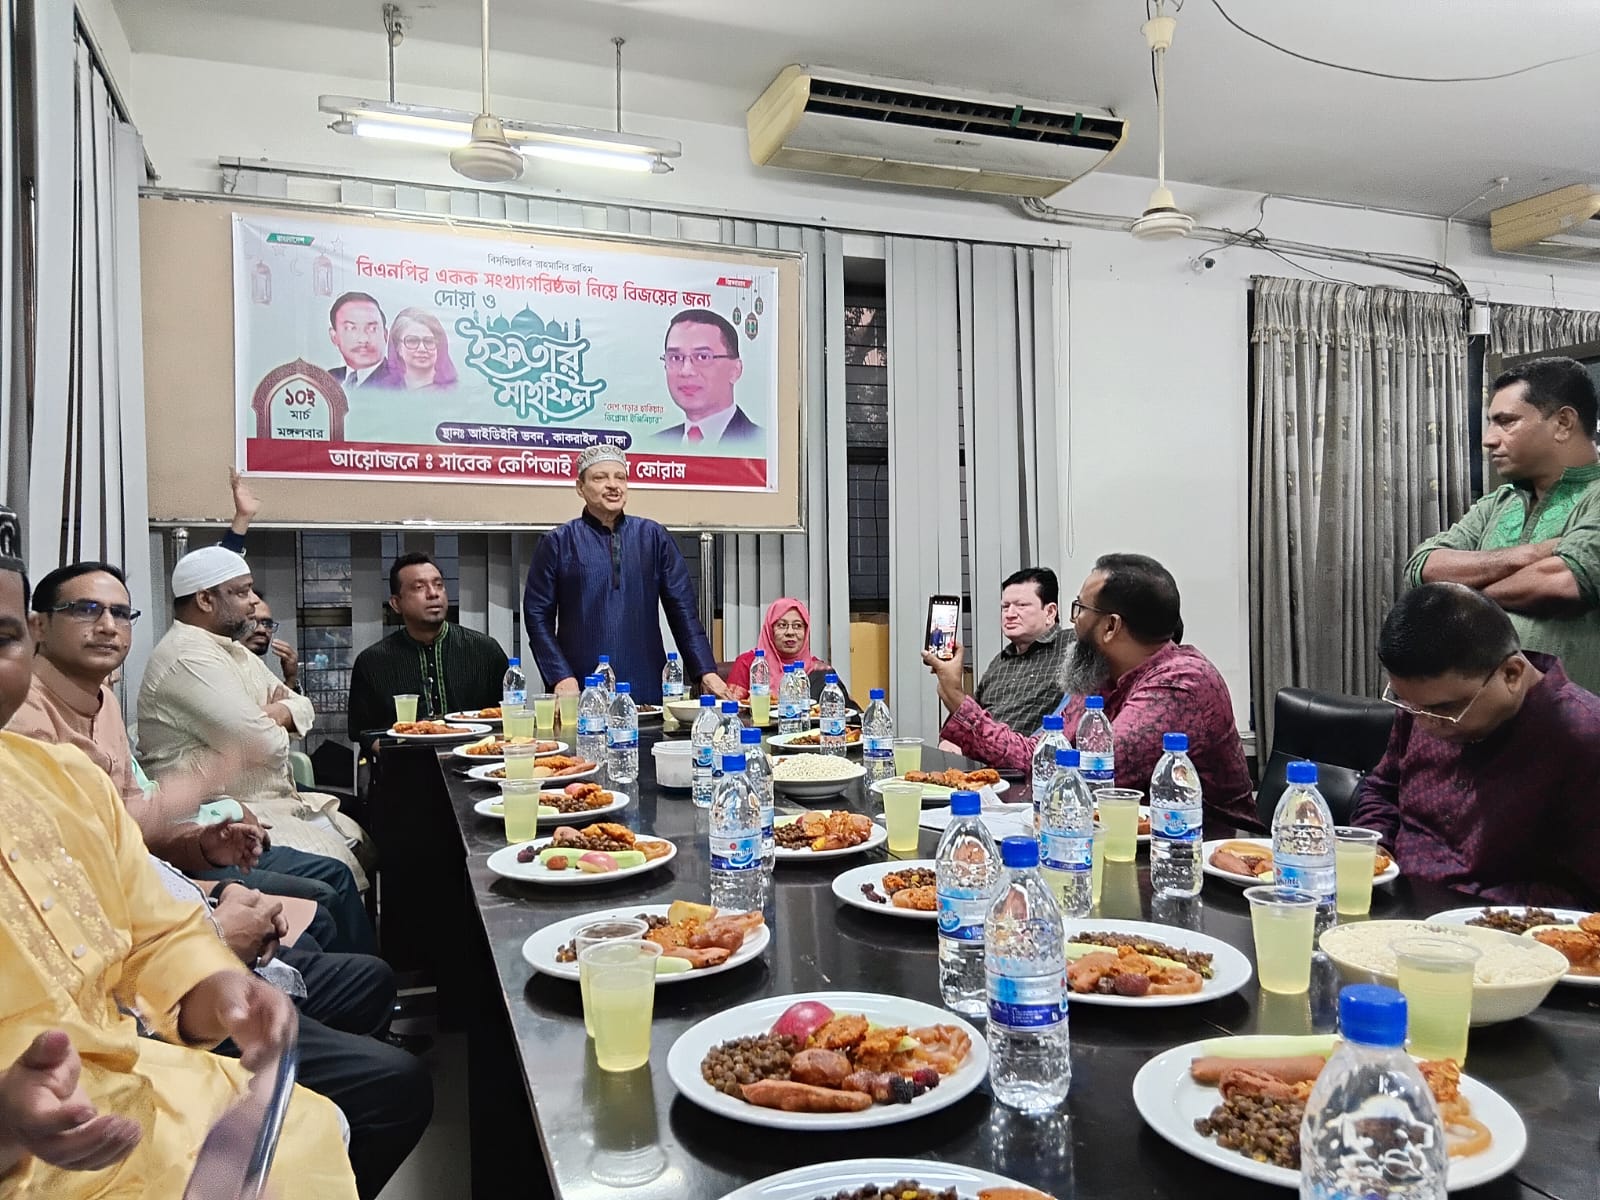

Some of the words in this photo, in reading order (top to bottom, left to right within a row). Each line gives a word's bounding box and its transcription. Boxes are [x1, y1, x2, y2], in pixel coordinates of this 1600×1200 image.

[356, 255, 430, 284] বিএনপির
[435, 268, 479, 286] একক
[483, 272, 581, 296] সংখ্যাগরিষ্ঠতা
[586, 277, 618, 301] নিয়ে
[623, 281, 678, 306] বিজয়ের
[682, 291, 711, 307] জন্য
[434, 289, 476, 310] দোয়া
[482, 294, 496, 309] ও
[457, 319, 590, 379] ইফতার
[284, 387, 316, 407] ১০ই
[490, 372, 606, 422] মাহফিল
[289, 408, 312, 421] মার্চ
[276, 427, 325, 439] মঙ্গলবার
[468, 426, 517, 444] আইডিইবি
[328, 448, 420, 471] আয়োজনে
[439, 453, 492, 472] সাবেক
[497, 453, 572, 476] কেপিআই
[636, 461, 687, 480] ফোরাম
